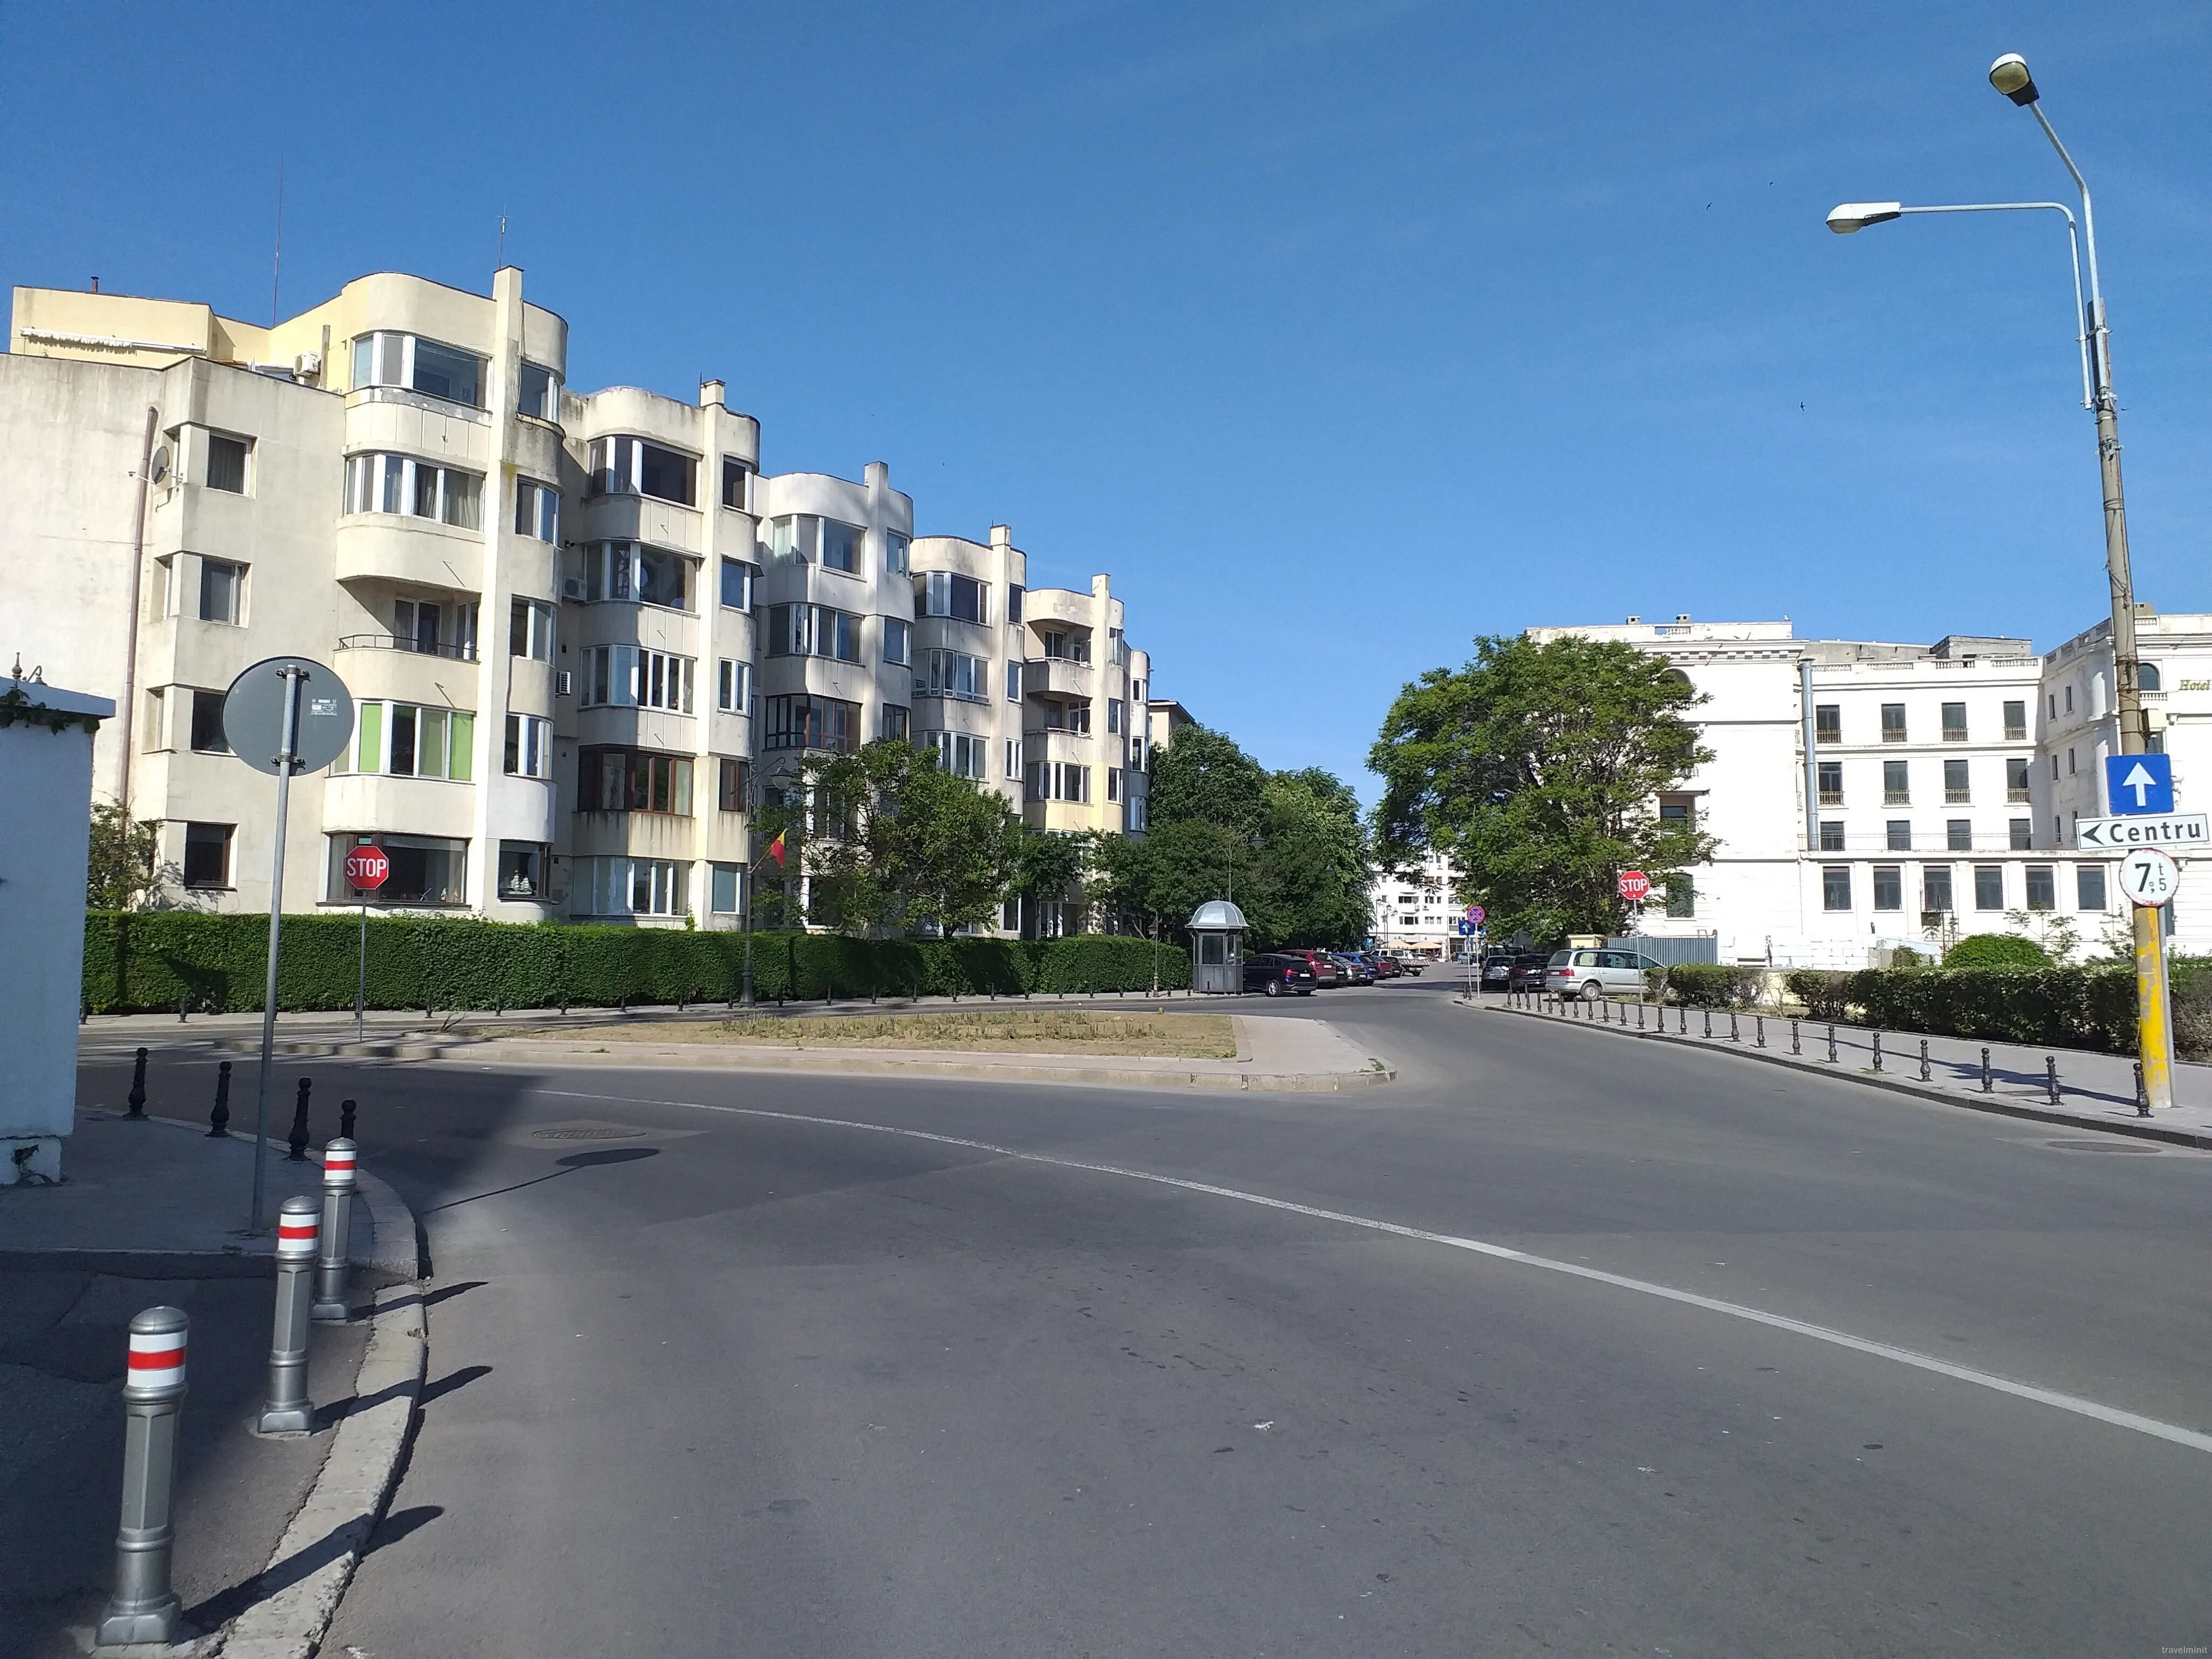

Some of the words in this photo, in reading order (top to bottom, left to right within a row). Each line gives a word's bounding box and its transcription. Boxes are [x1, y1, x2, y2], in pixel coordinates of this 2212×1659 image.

[2179, 679, 2210, 690] Hotel
[2110, 821, 2201, 842] Centru
[347, 858, 387, 878] STOP
[1621, 878, 1648, 892] STOP
